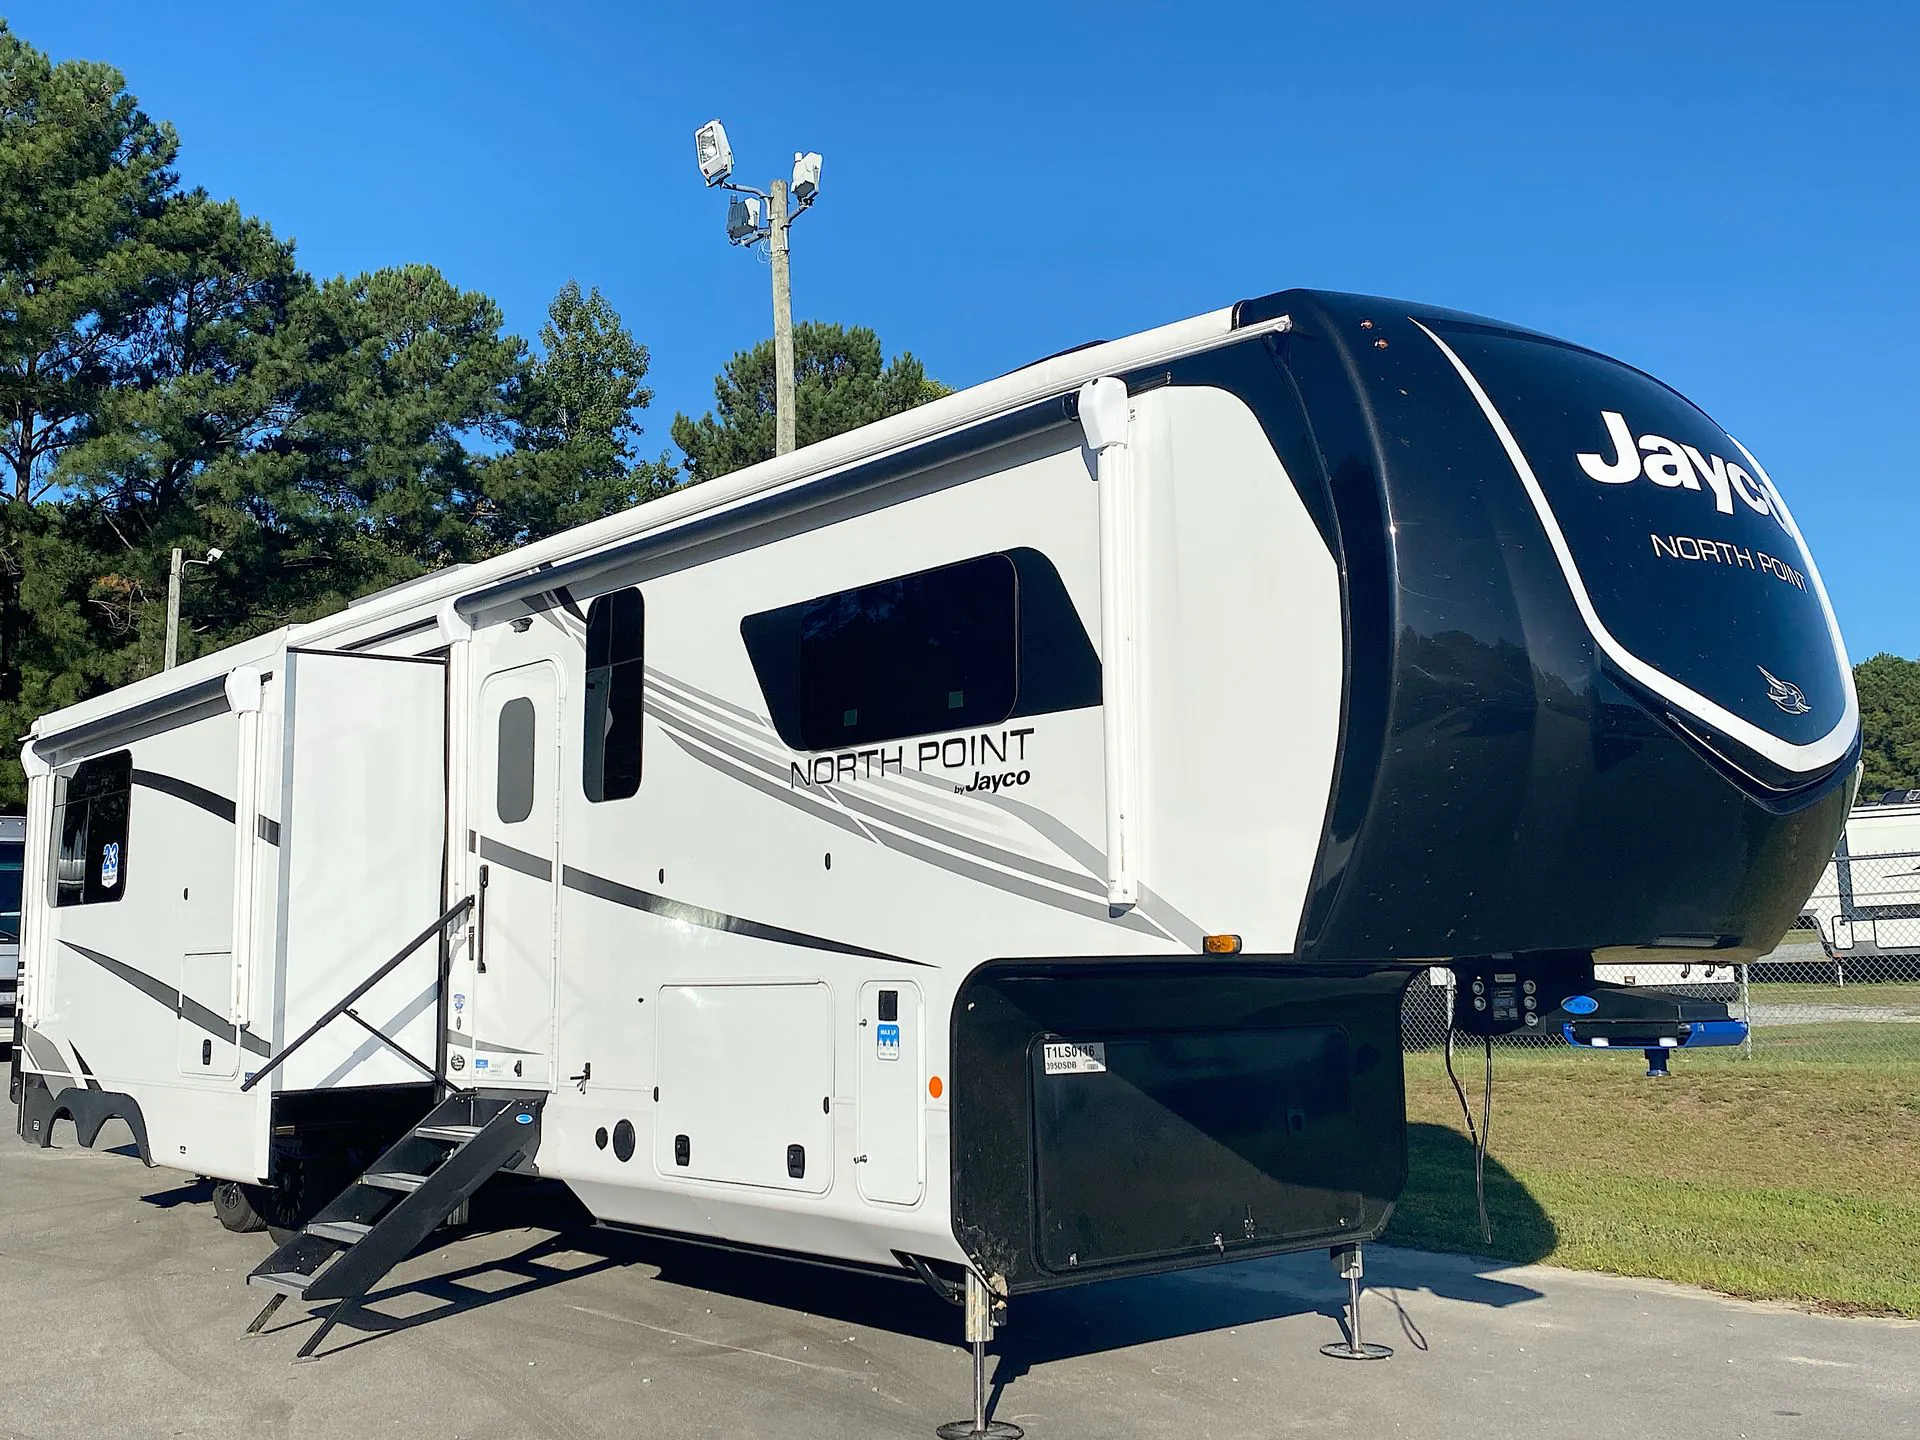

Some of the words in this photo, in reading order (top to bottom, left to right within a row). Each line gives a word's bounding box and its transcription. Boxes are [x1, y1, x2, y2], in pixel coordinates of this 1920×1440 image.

[1650, 534, 1756, 571] NORTH
[1756, 551, 1808, 594] POINT
[791, 746, 903, 790] NORTH
[918, 727, 1035, 772] POINT
[953, 784, 965, 795] by
[965, 769, 1031, 794] Jayco
